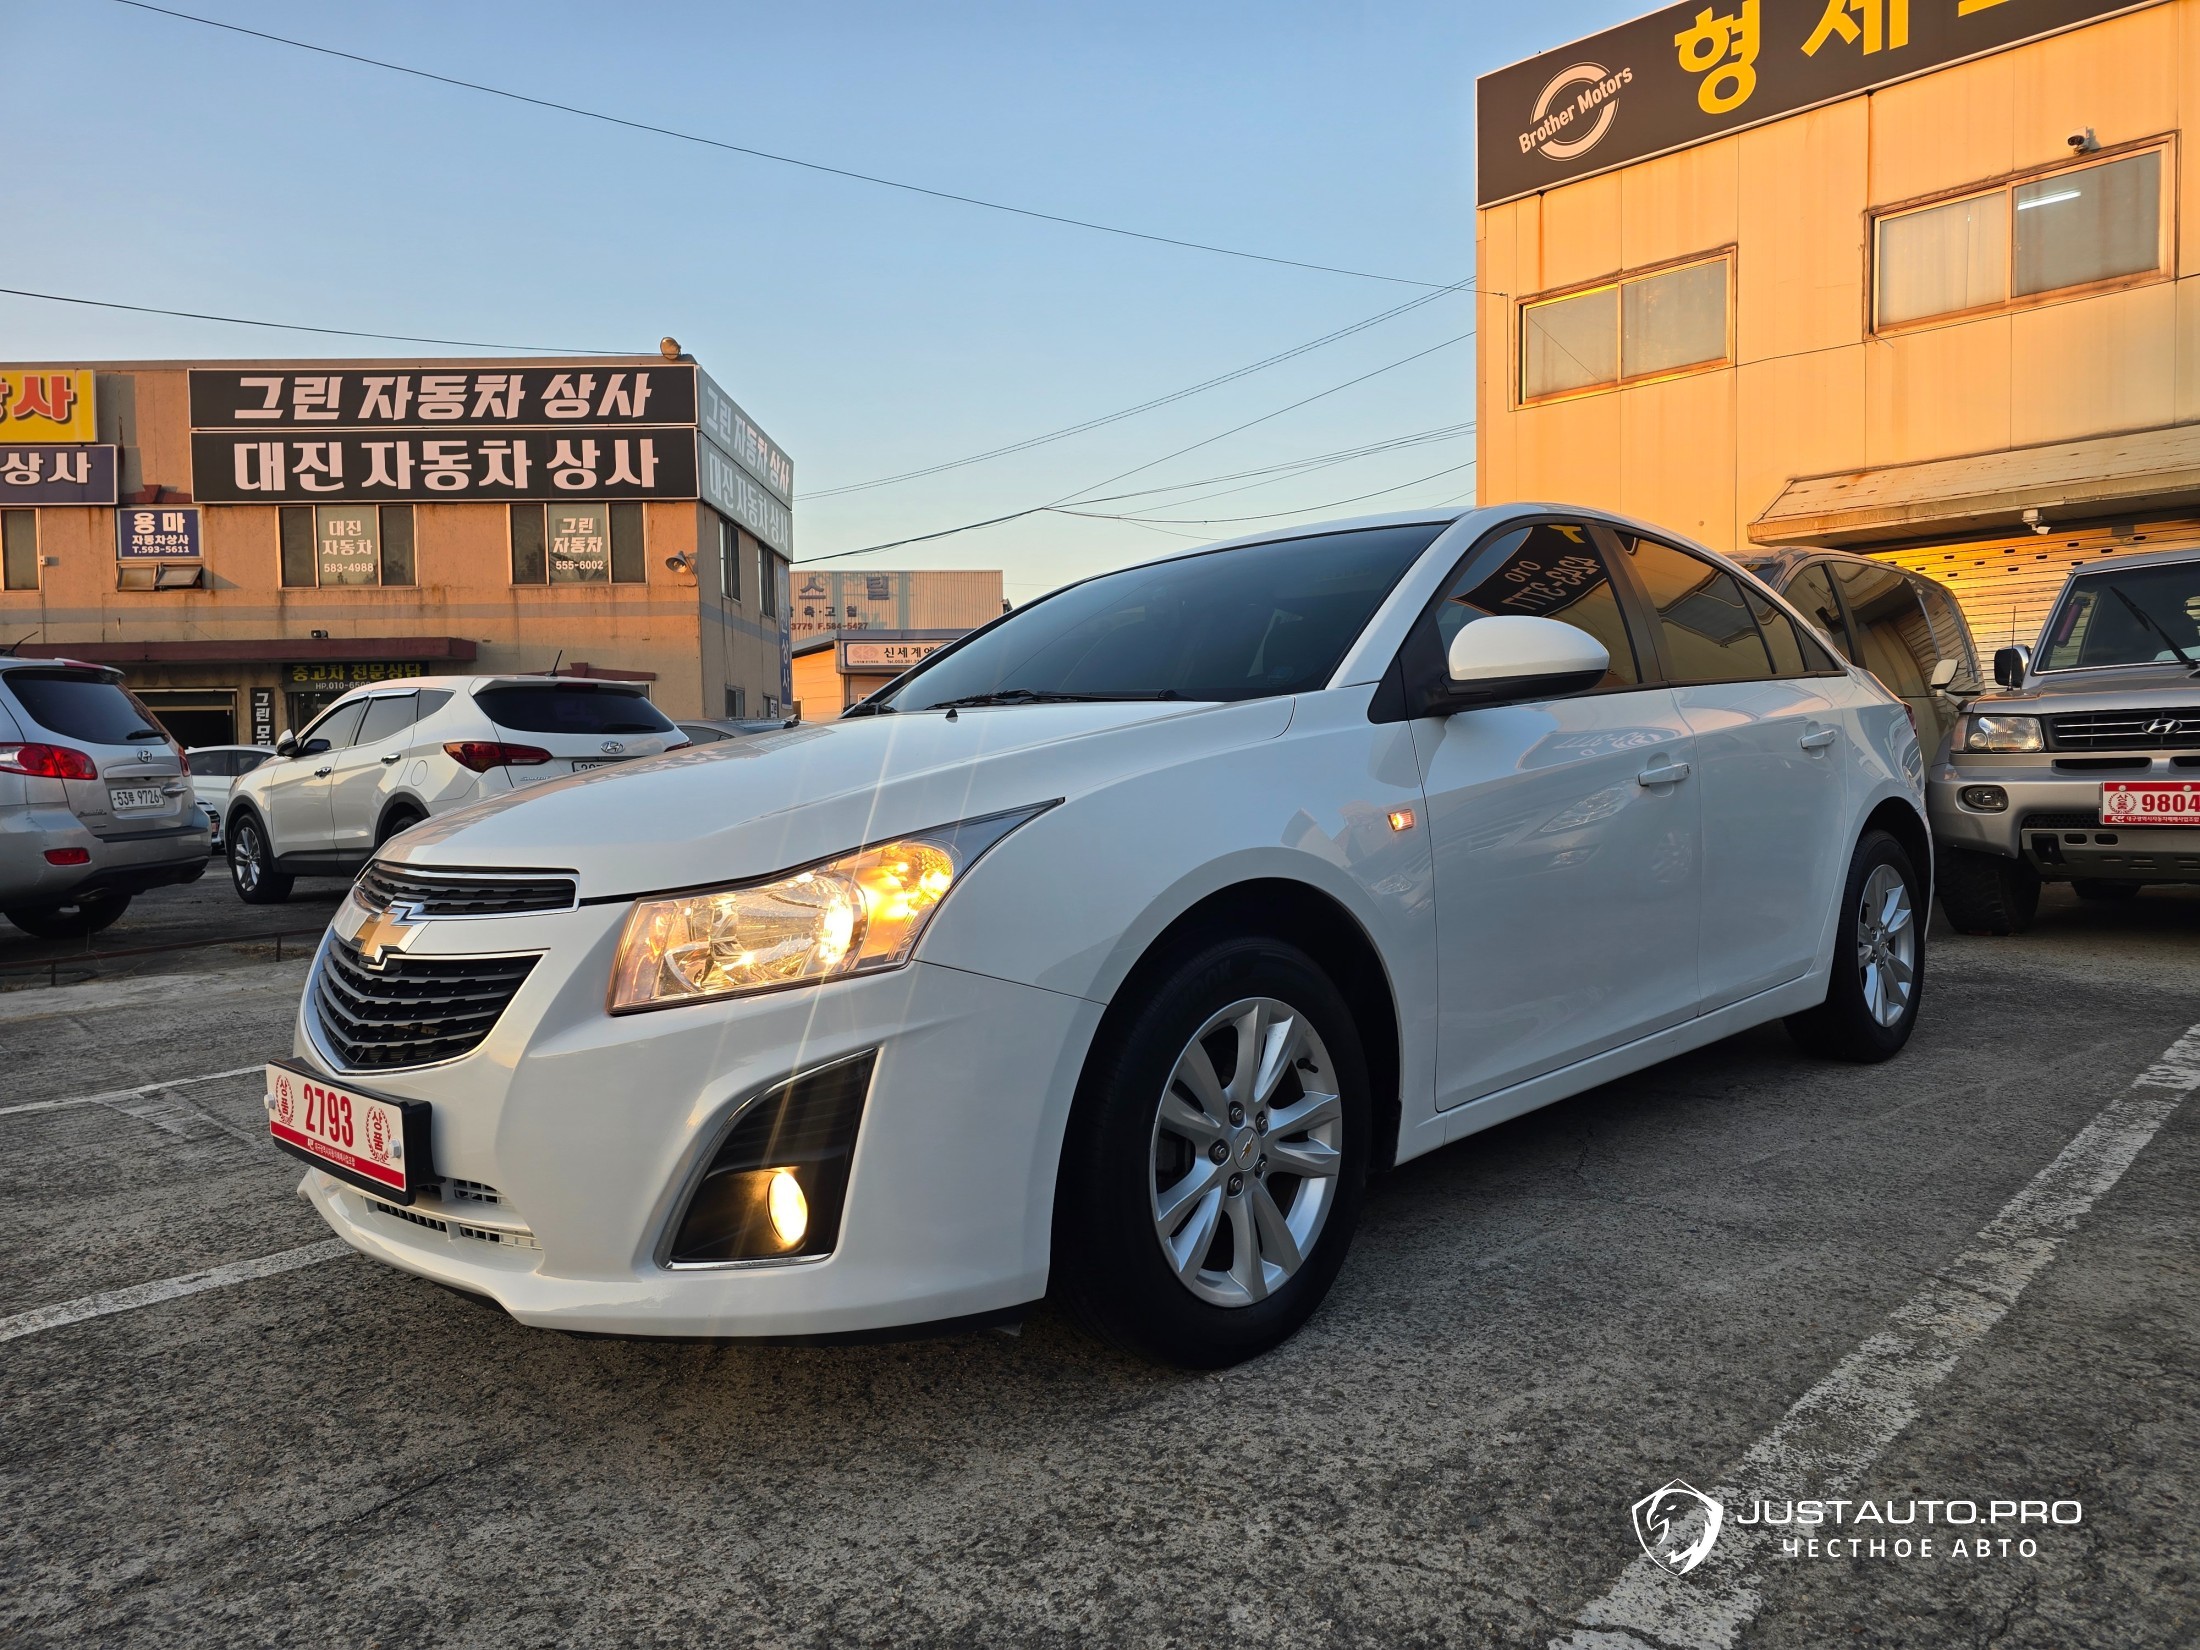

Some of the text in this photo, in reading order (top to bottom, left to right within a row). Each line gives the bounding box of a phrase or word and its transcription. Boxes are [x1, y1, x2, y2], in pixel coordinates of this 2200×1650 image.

[1518, 67, 1633, 153] Brother Motors
[235, 373, 652, 421] 그린 자동차 상사
[706, 386, 790, 497] 그린 자동차 상사
[234, 438, 659, 492] 대진 자동차 상사
[708, 451, 789, 551] 대진 자동차 상사
[133, 513, 186, 534] 용마
[329, 520, 362, 536] 대진
[561, 518, 593, 534] 그린
[132, 535, 189, 545] 자동차상사
[322, 540, 373, 556] 자동차
[553, 537, 602, 553] 자동차
[132, 546, 190, 554] T.593-5611
[324, 563, 374, 573] 583-4988
[555, 560, 604, 570] 555-6002
[292, 663, 422, 681] 중고차 전문상담
[255, 692, 271, 722] 그린
[137, 789, 160, 805] 9726
[2141, 793, 2200, 813] 9804
[303, 1083, 354, 1148] 2793
